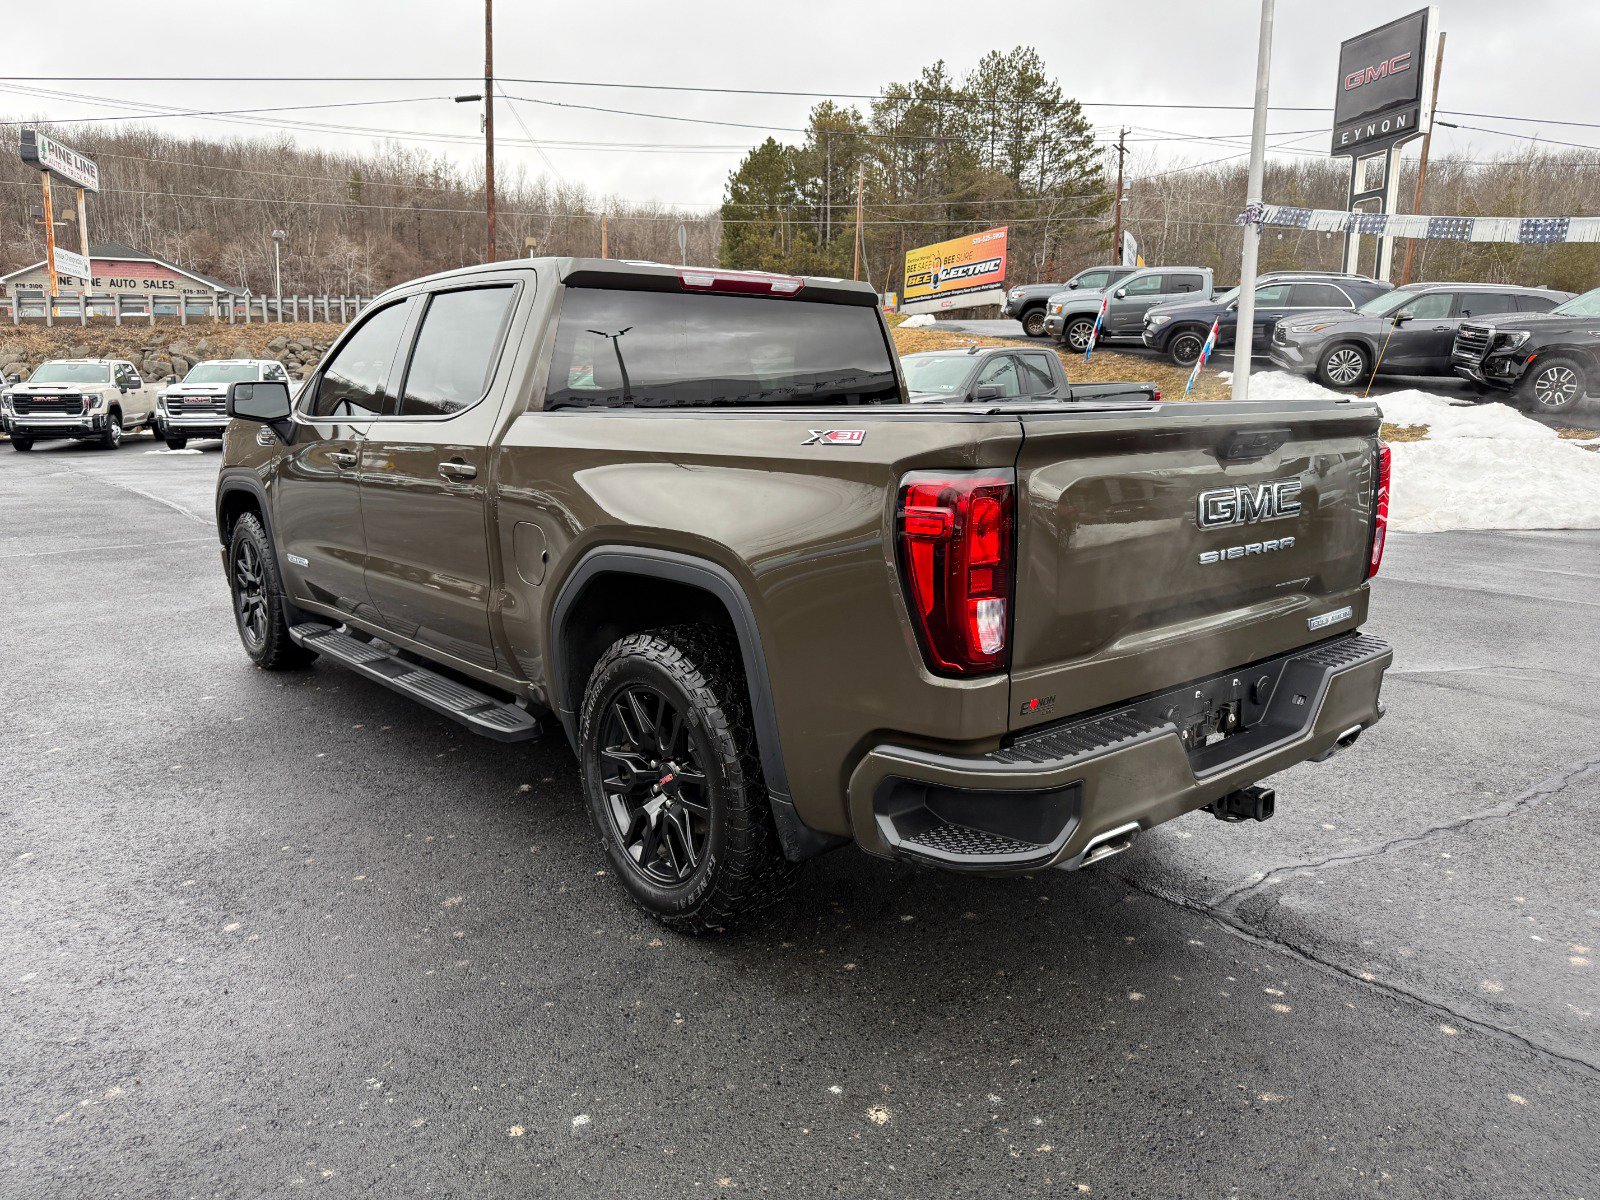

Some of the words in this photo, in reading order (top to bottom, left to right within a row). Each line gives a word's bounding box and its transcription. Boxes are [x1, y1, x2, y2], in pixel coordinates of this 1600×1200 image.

[1344, 52, 1411, 91] GMC
[1341, 115, 1406, 145] EYNON
[48, 140, 72, 166] PINE
[74, 155, 96, 178] LINE
[907, 263, 917, 274] BEE
[943, 254, 955, 265] BEE
[956, 251, 974, 263] SURE
[80, 277, 102, 287] LNE
[109, 278, 137, 289] AUTO
[143, 279, 175, 290] SALES
[908, 275, 931, 286] BEE
[800, 429, 866, 446] X31
[1197, 478, 1302, 531] GMC
[1198, 536, 1296, 565] SIERRA
